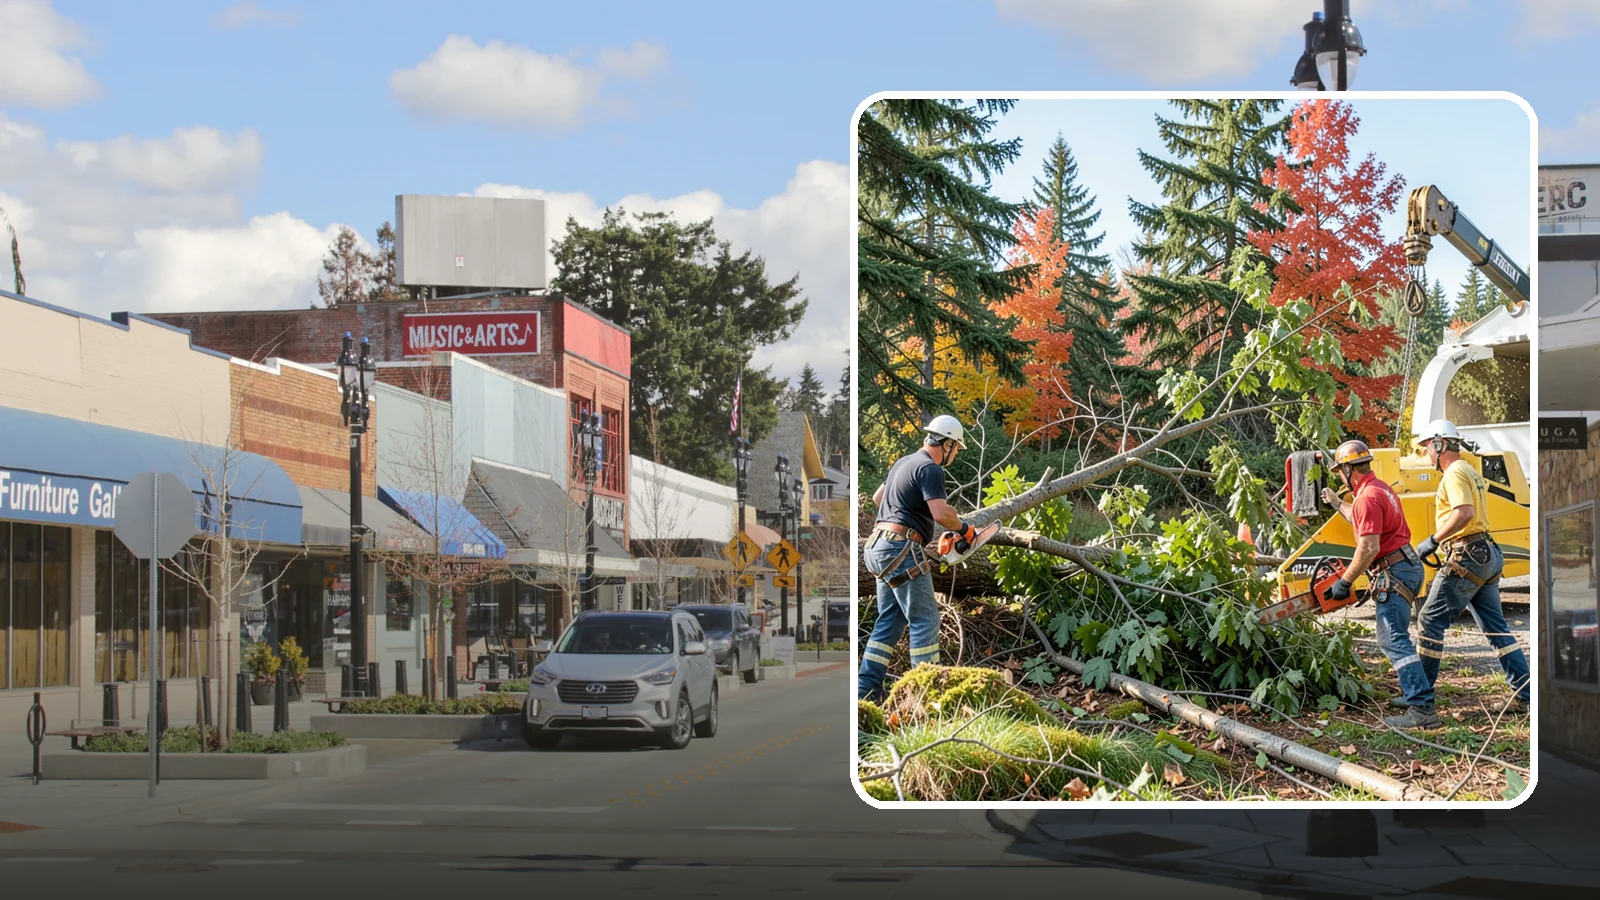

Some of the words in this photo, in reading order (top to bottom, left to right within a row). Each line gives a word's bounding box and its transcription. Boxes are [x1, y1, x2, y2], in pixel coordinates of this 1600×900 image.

[409, 323, 519, 349] MUSIC&ARTS
[0, 471, 79, 515] Furniture
[89, 482, 121, 519] Gal
